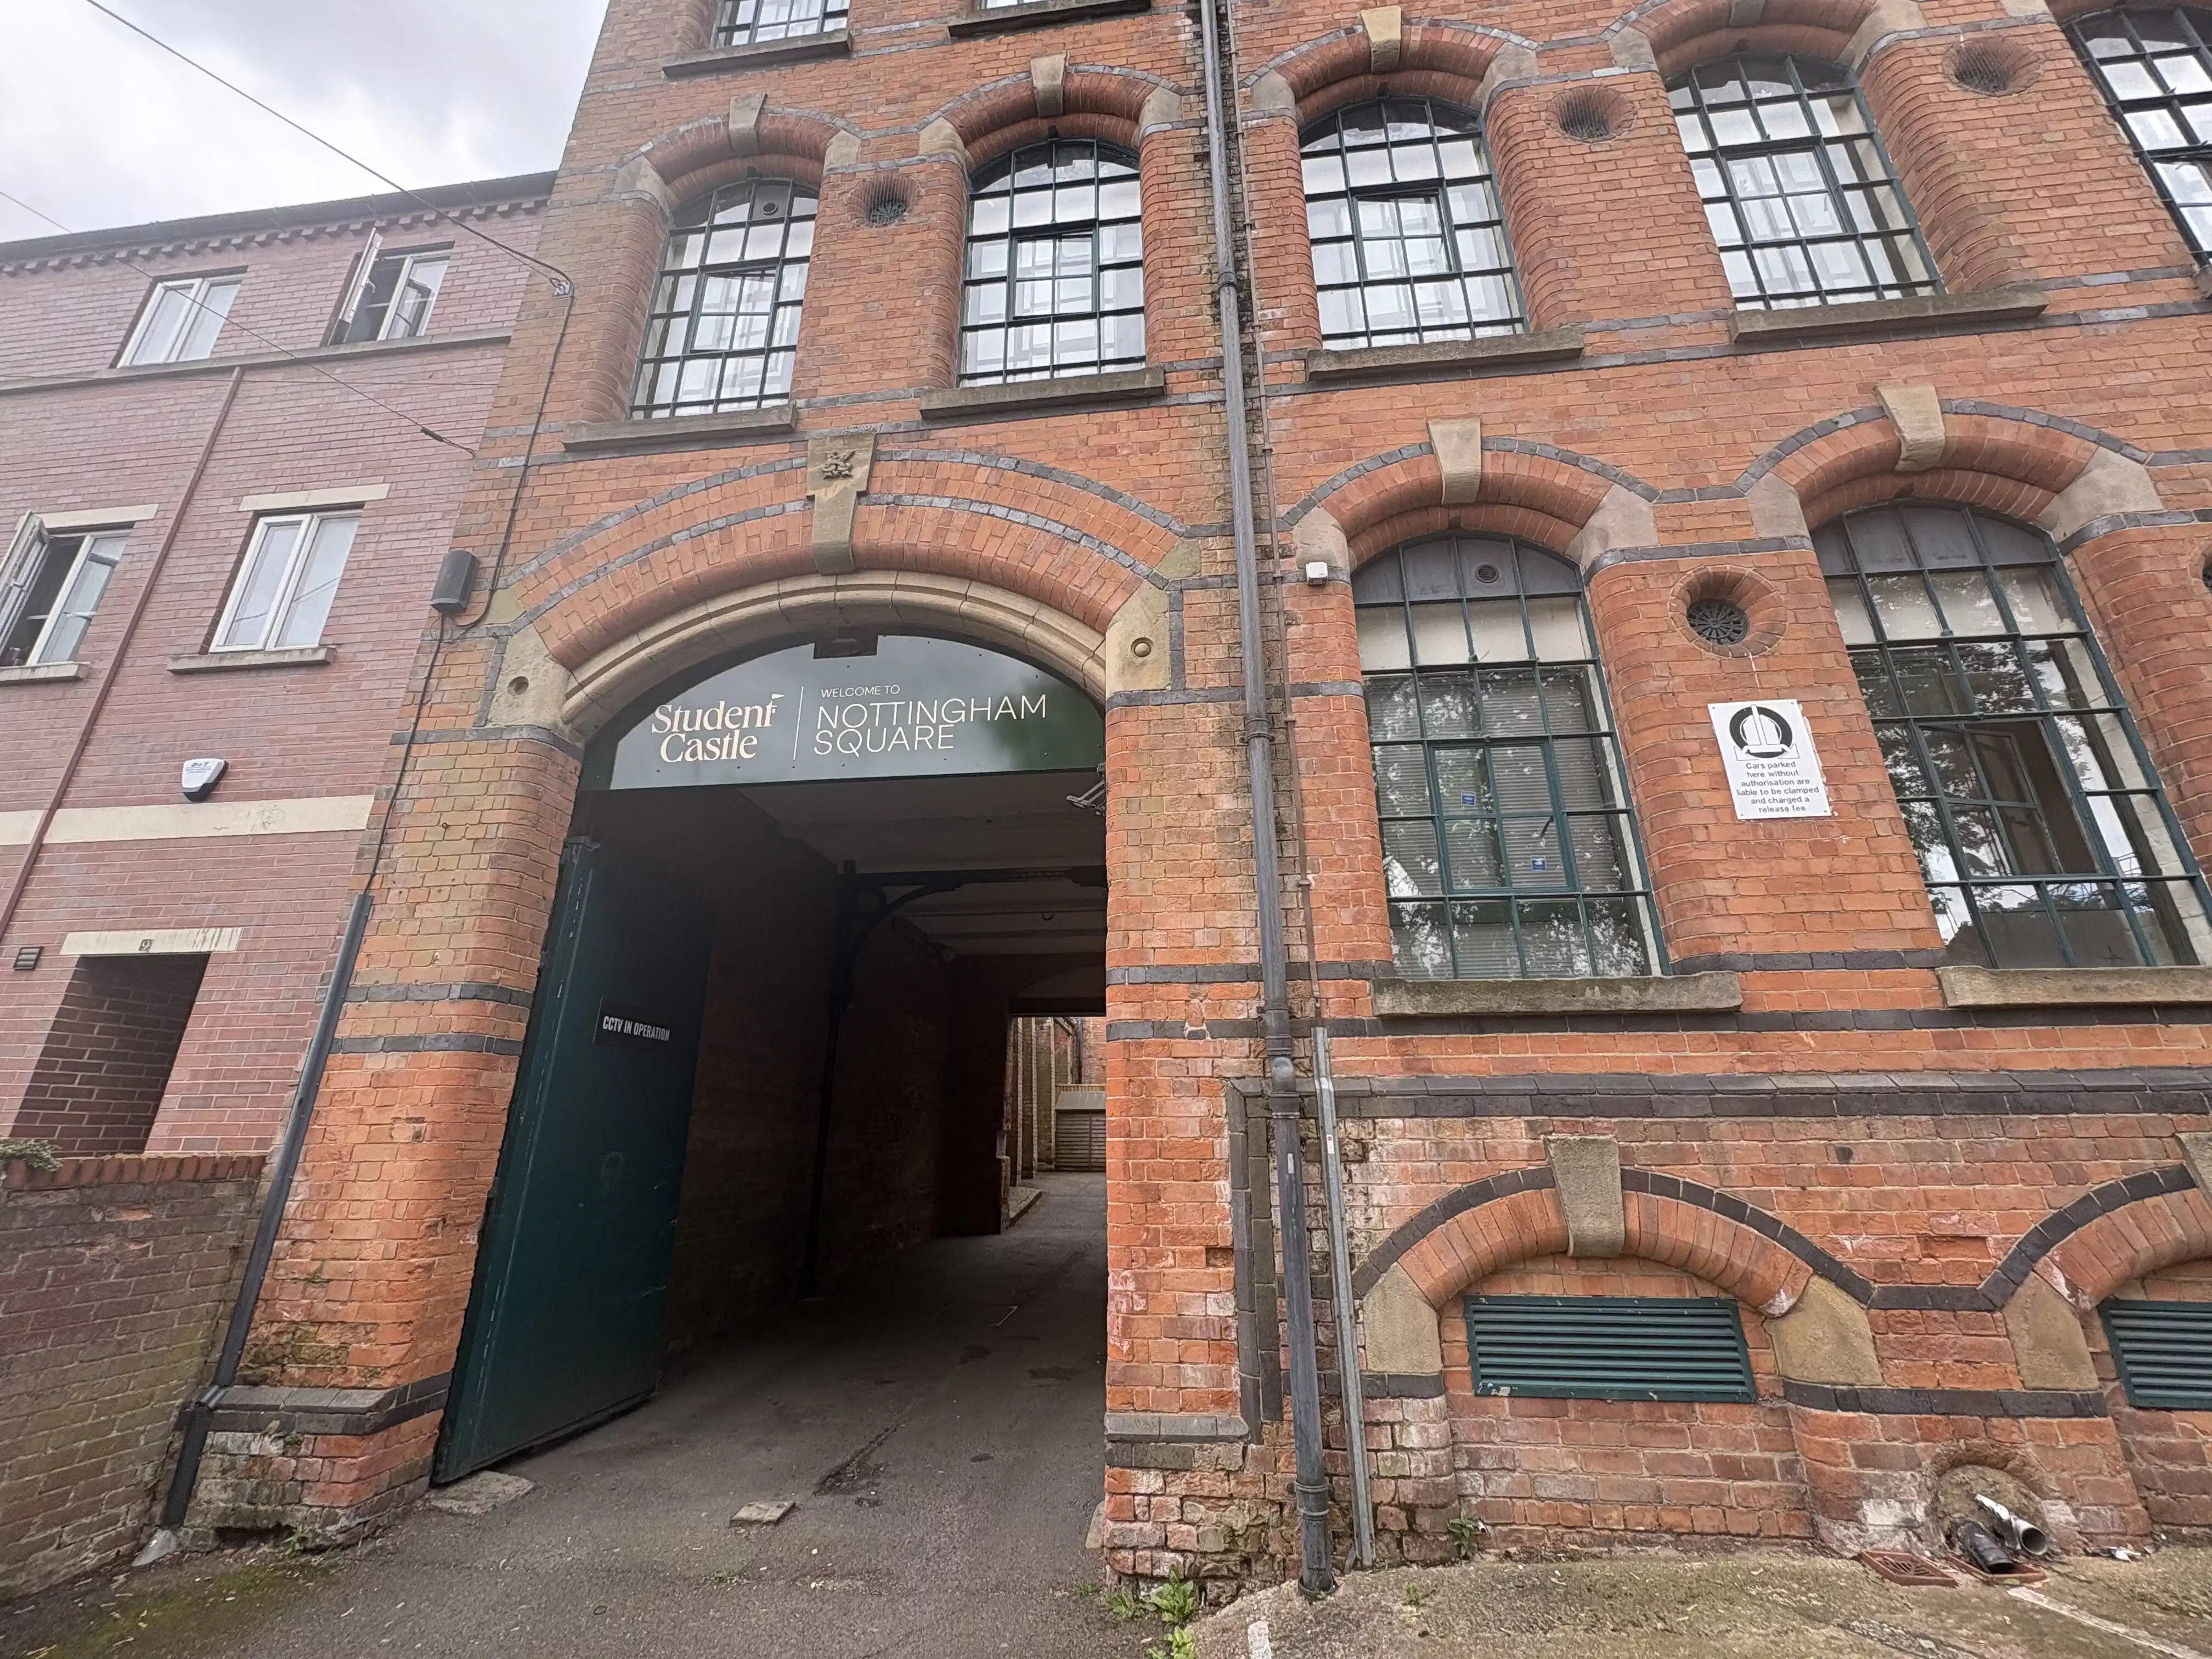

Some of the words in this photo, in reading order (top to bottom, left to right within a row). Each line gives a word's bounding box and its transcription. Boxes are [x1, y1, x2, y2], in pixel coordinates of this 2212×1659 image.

[821, 686, 882, 697] WELCOME
[884, 685, 900, 695] TO
[651, 695, 781, 732] Student
[816, 693, 1047, 730] NOTTINGHAM
[661, 729, 758, 763] Castle
[813, 724, 954, 758] SQUARE
[1768, 761, 1796, 770] parked
[1768, 797, 1802, 805] charged
[1784, 787, 1819, 795] clamped
[602, 1016, 623, 1032] CCTV
[624, 1020, 633, 1034] IN
[633, 1023, 670, 1041] OPERATION
